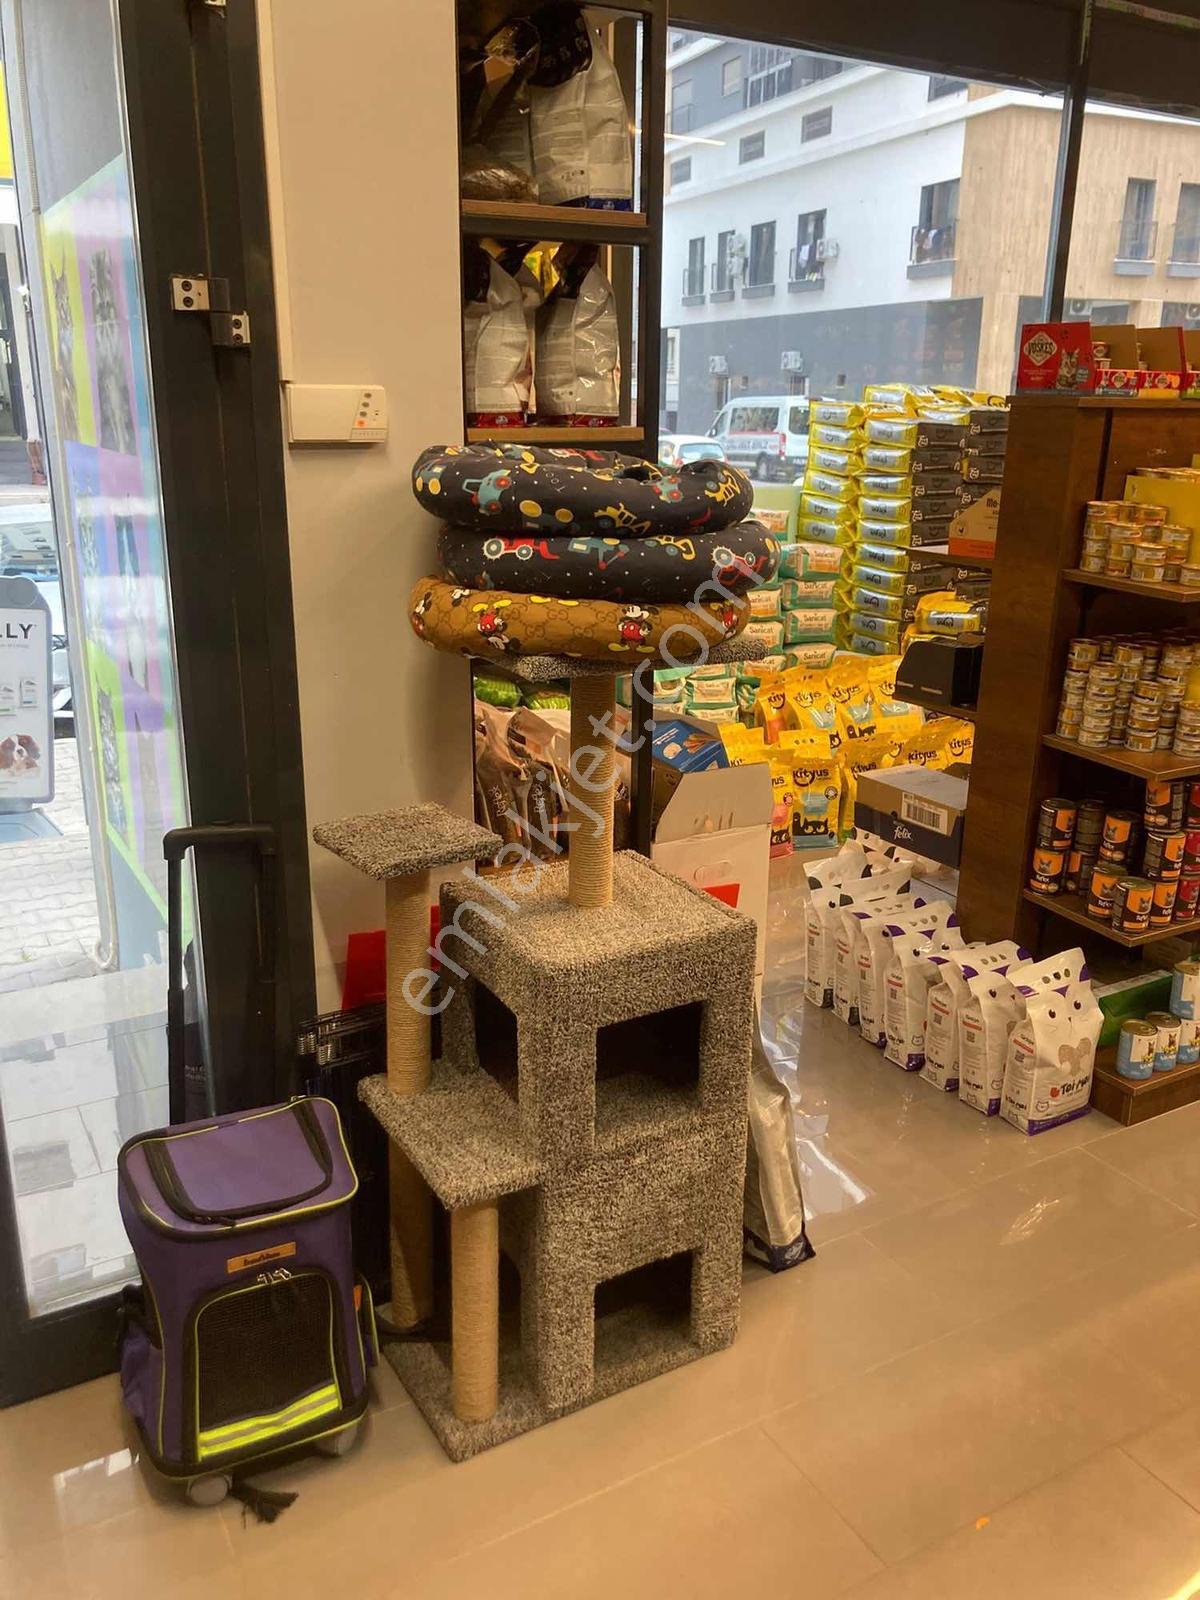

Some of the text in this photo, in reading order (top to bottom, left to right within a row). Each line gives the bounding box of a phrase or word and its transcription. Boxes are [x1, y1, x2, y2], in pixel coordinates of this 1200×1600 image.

[803, 612, 827, 623] Sanicat
[749, 623, 774, 635] Sanicat
[803, 650, 827, 661] Sanicat
[767, 692, 786, 710] Kity
[908, 749, 938, 766] Kityus
[792, 765, 830, 788] Kityus
[894, 825, 912, 841] felix
